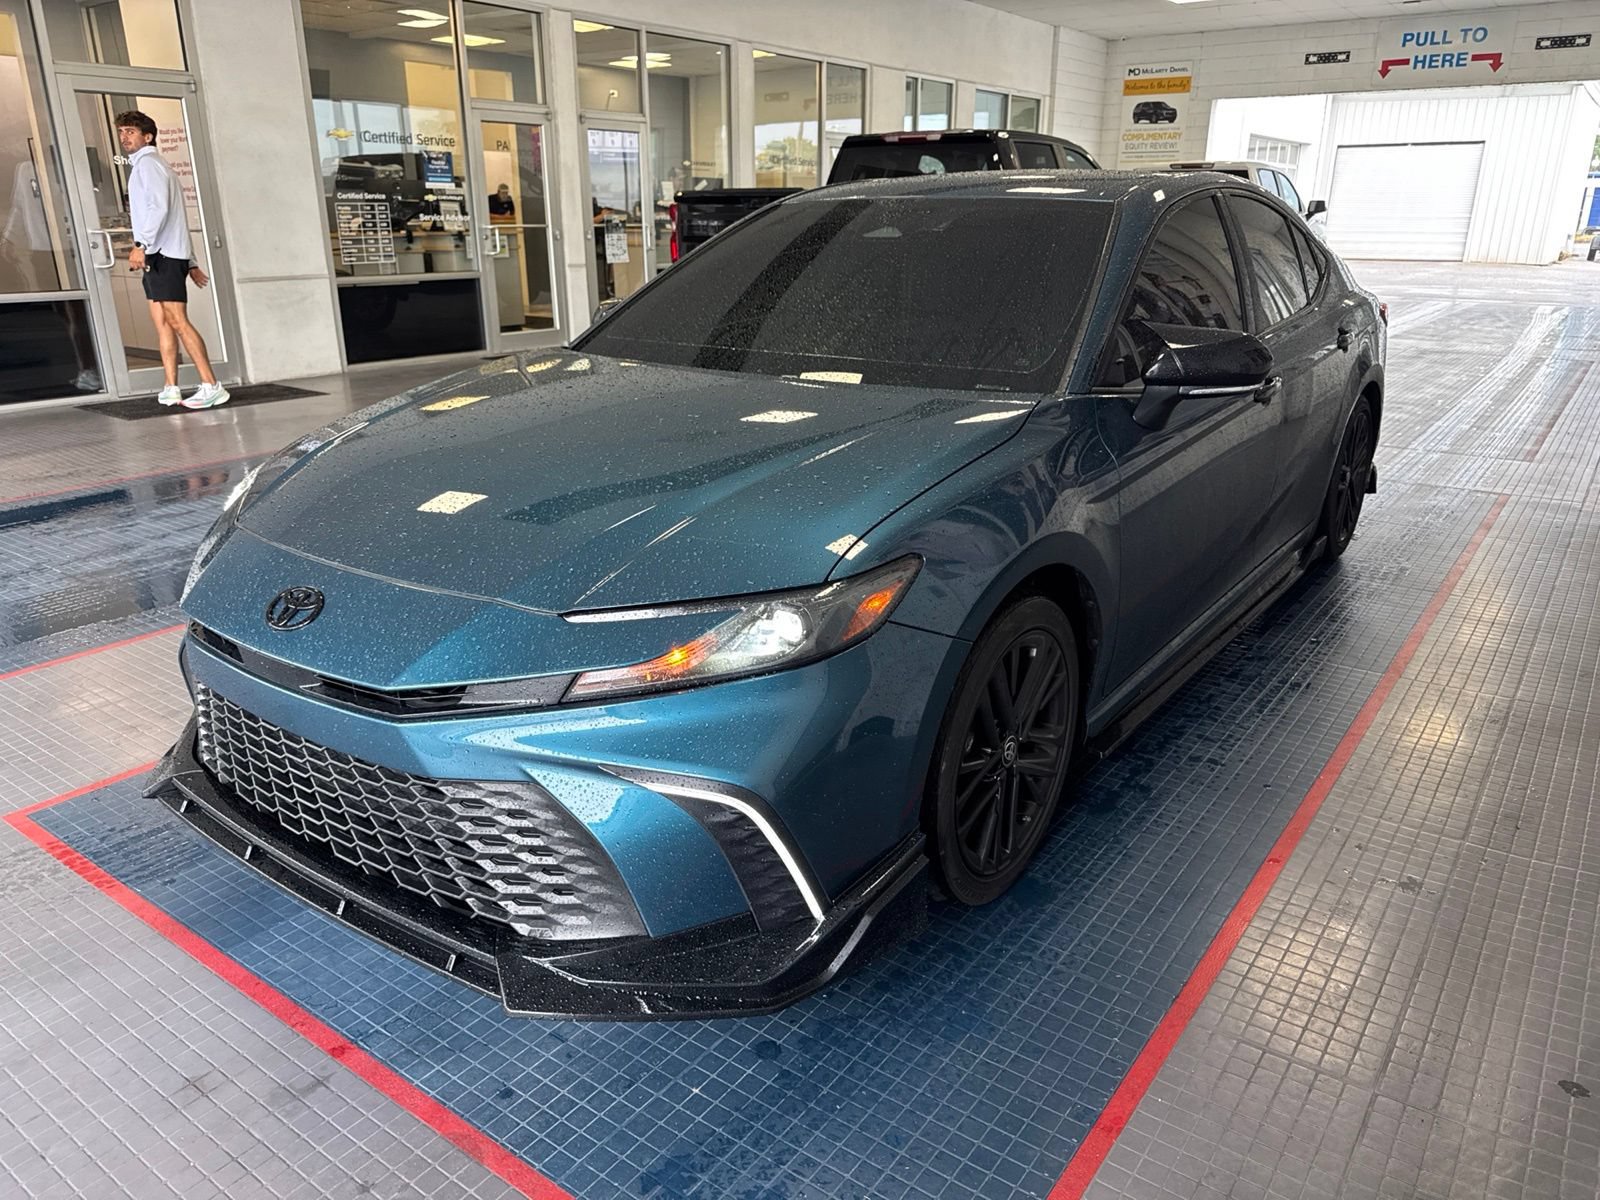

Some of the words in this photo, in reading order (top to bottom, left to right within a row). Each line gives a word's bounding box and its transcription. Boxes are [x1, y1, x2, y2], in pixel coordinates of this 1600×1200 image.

[1401, 30, 1453, 47] PULL
[1459, 26, 1489, 44] TO
[1412, 52, 1469, 70] HERE
[416, 133, 456, 147] Service
[1122, 132, 1182, 141] COMPLIMENTARY
[1124, 142, 1148, 150] EQUITY
[337, 192, 363, 200] Certified
[364, 192, 387, 200] Service
